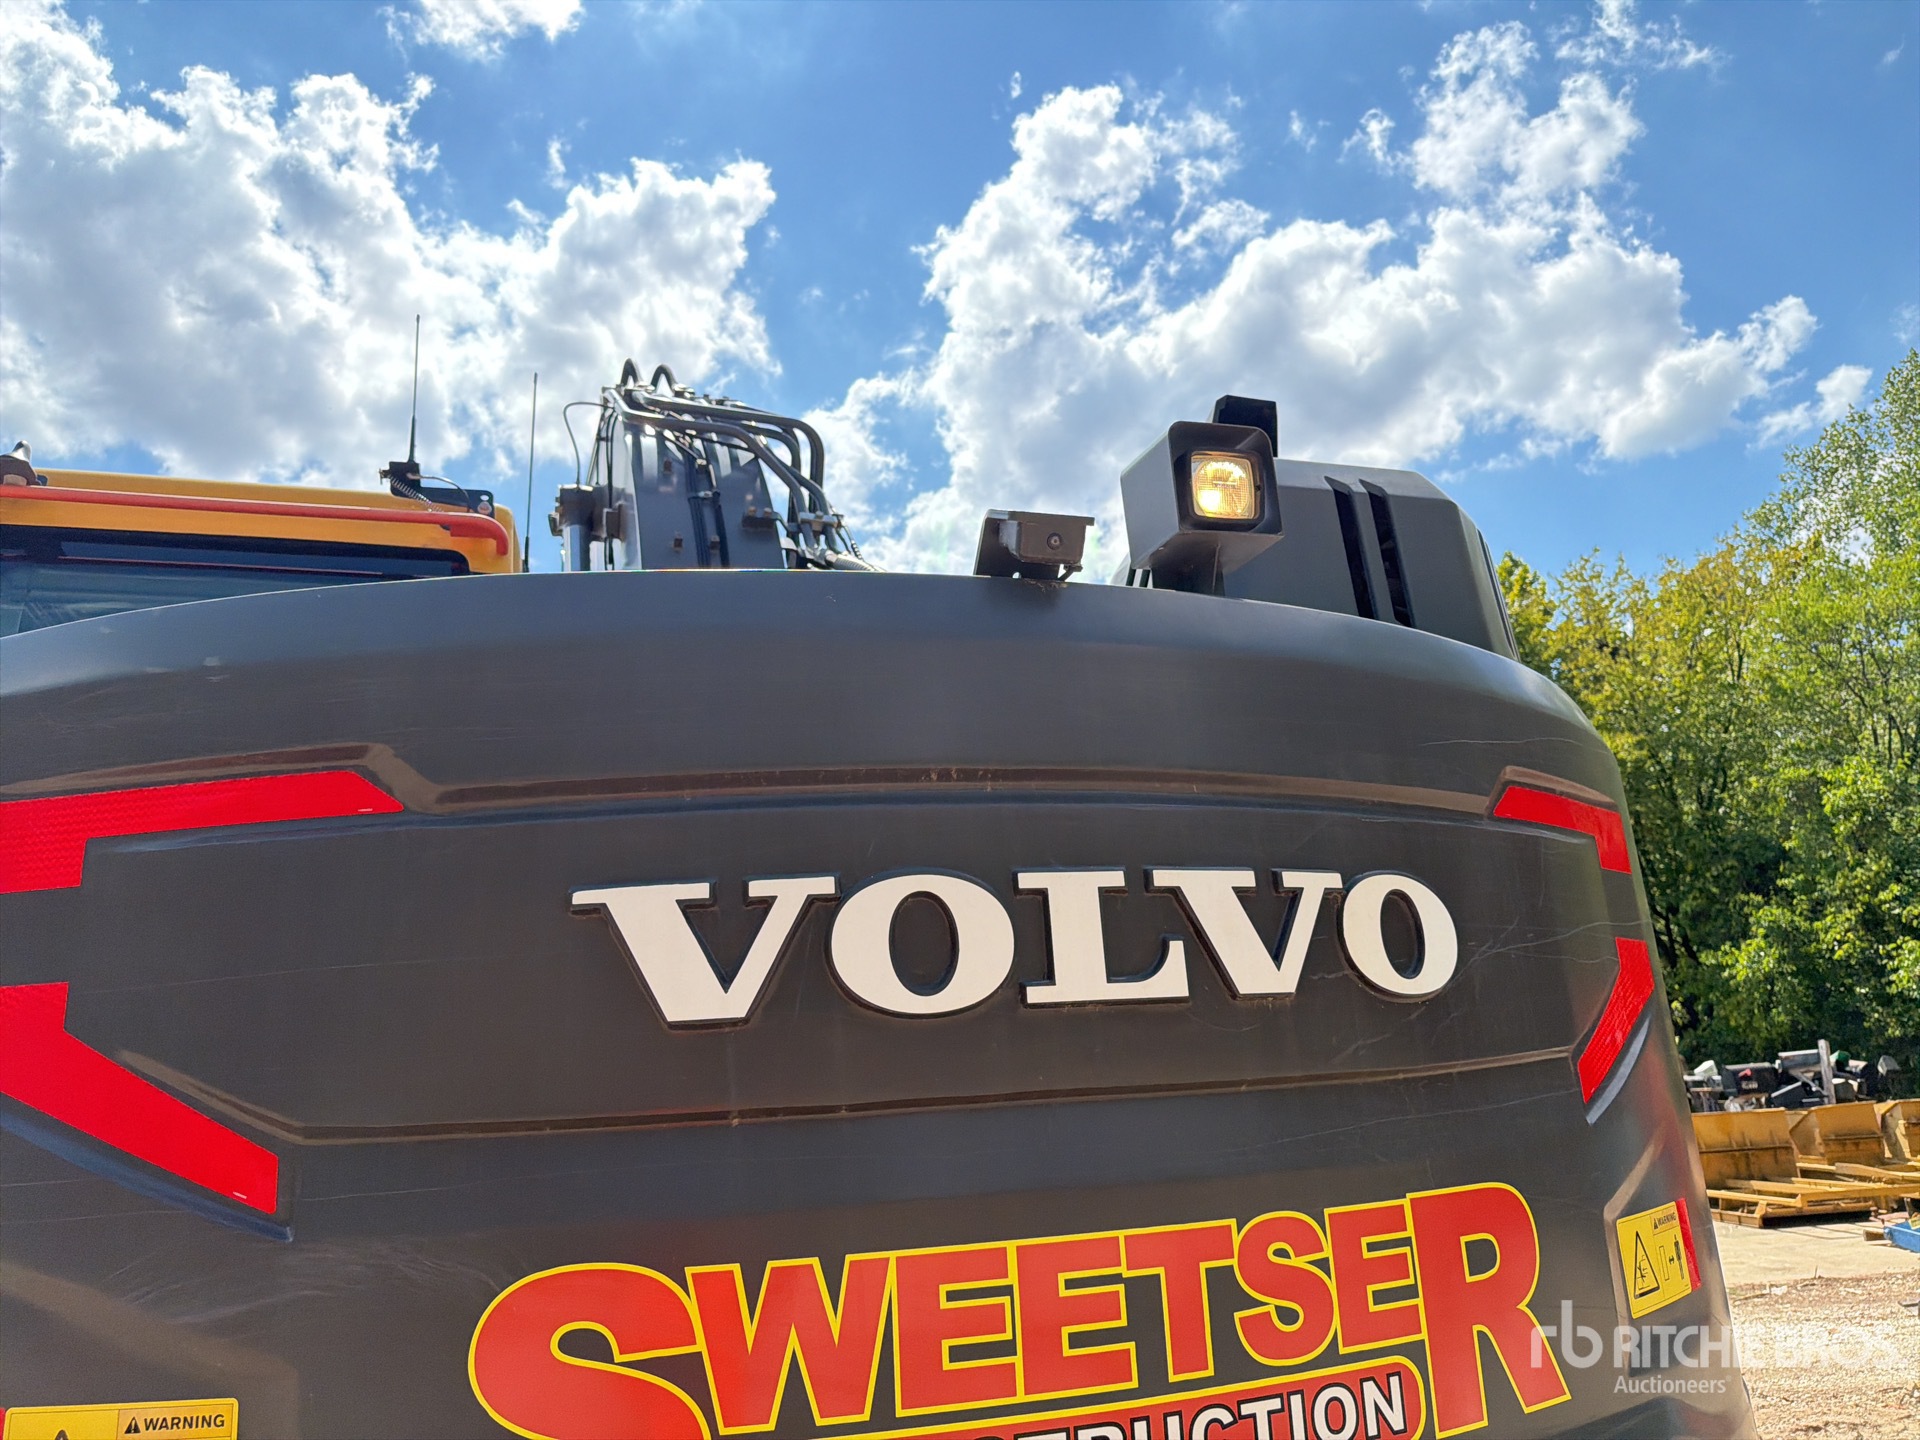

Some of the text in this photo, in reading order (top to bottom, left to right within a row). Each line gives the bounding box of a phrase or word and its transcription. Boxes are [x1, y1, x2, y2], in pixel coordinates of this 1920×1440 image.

[570, 868, 1459, 1024] VOLVO
[1657, 1212, 1677, 1226] WARNING
[467, 1182, 1572, 1440] SWEETSER
[144, 1414, 225, 1431] WARNING
